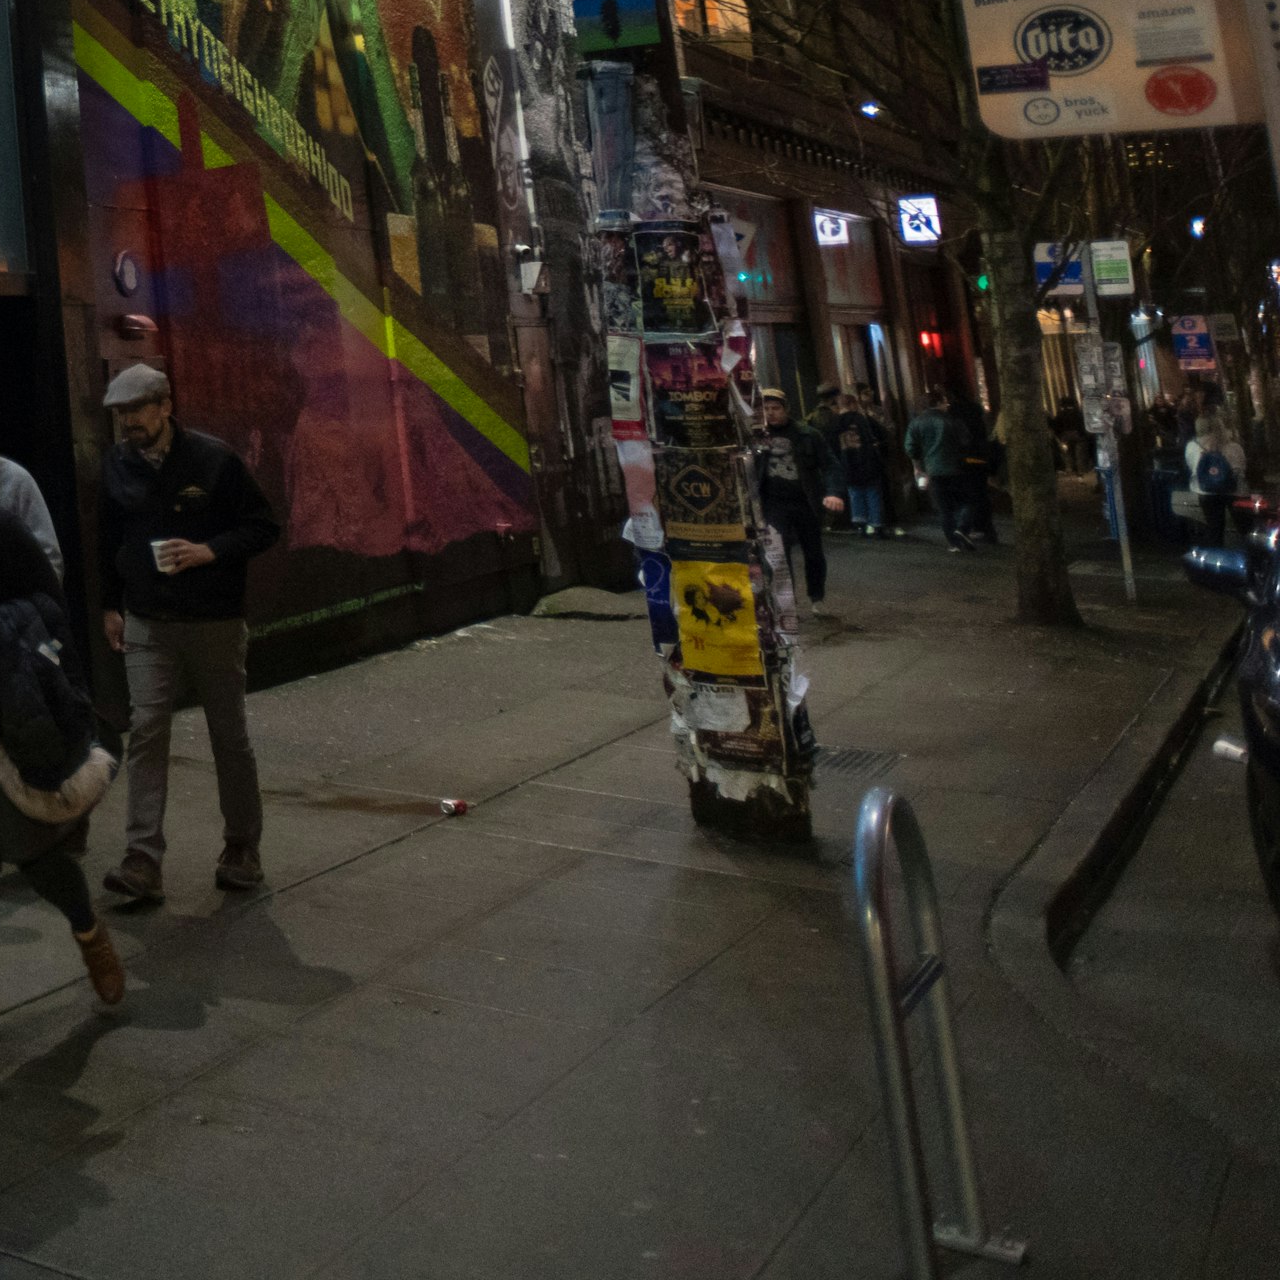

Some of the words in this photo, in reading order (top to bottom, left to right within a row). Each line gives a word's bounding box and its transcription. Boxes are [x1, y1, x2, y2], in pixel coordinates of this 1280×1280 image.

[1138, 6, 1196, 20] amazon
[1075, 106, 1110, 119] yuck
[668, 391, 718, 402] ZOMBOY
[680, 482, 712, 497] SCW
